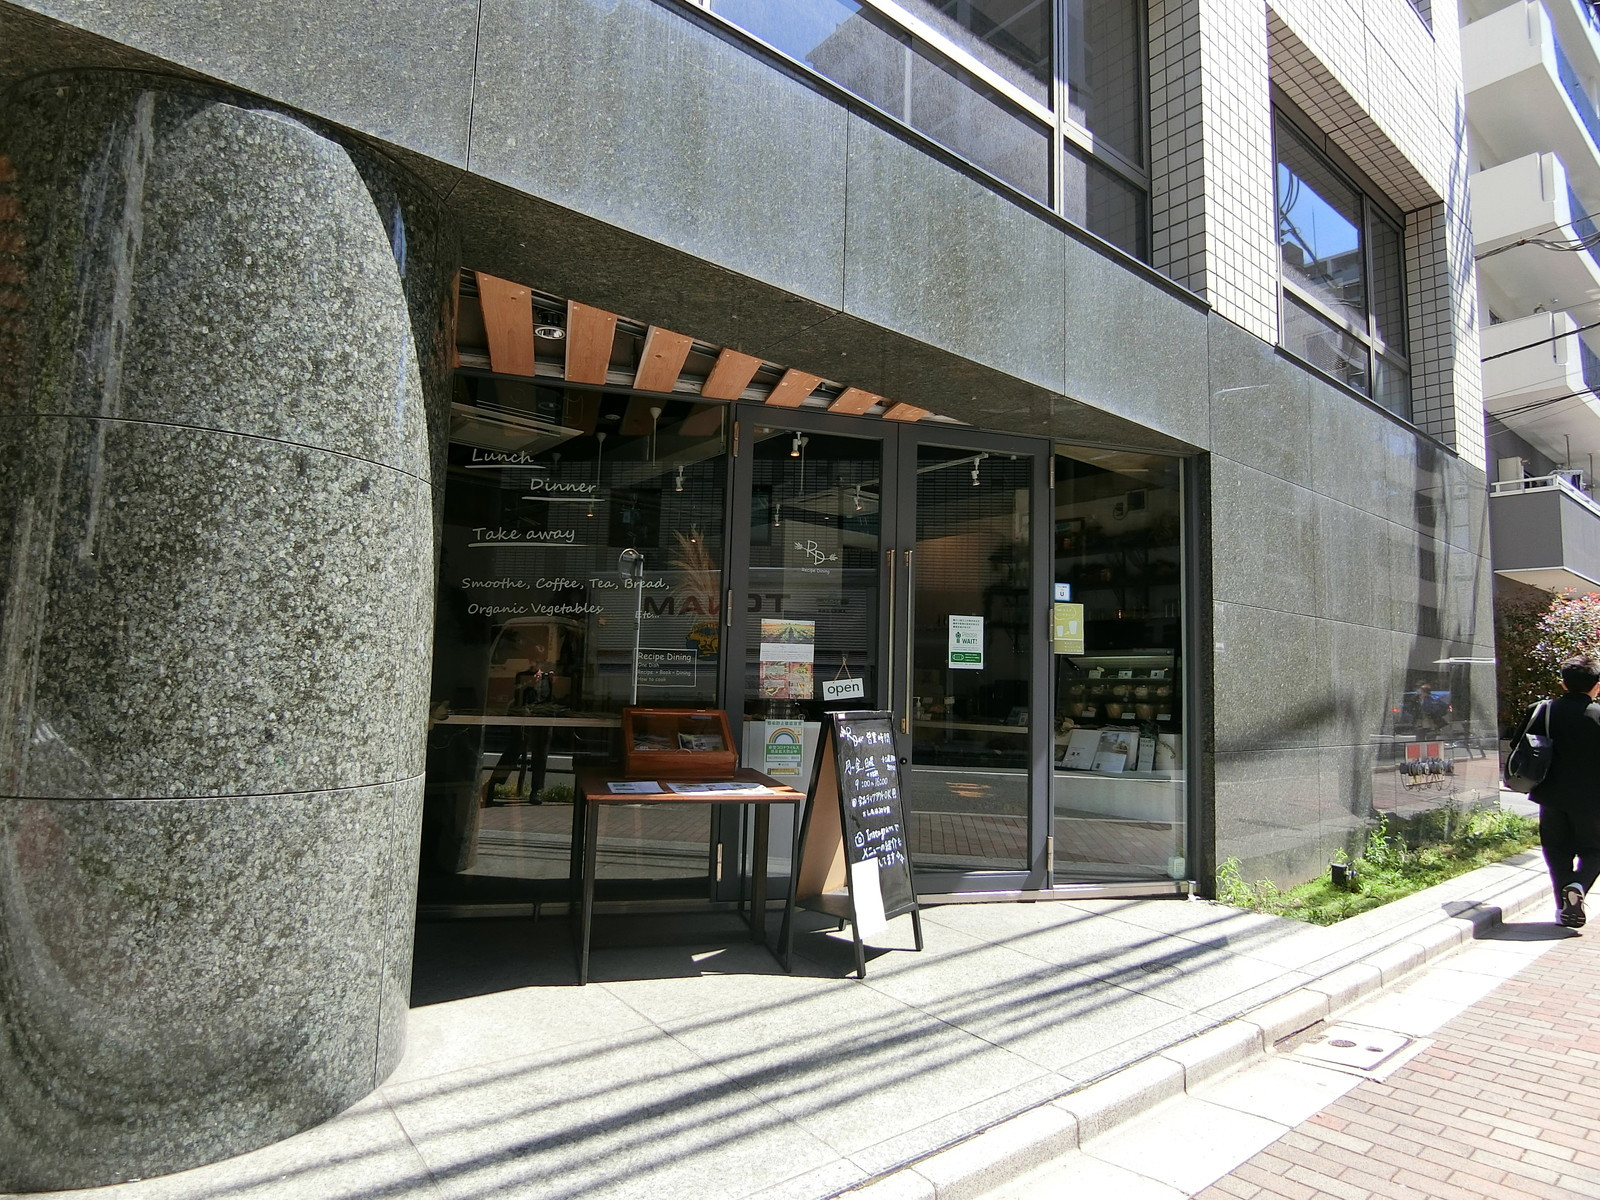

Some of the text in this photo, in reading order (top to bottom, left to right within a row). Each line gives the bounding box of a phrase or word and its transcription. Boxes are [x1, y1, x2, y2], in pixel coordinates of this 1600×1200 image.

[471, 448, 535, 464] Lunch
[529, 478, 597, 493] Dinner
[472, 527, 575, 542] Take away
[462, 577, 670, 592] Smoothe, Coffee, Tea, Bread,
[468, 602, 604, 616] Organic Vegetables
[638, 652, 692, 663] Recipe Dining
[827, 682, 860, 697] open
